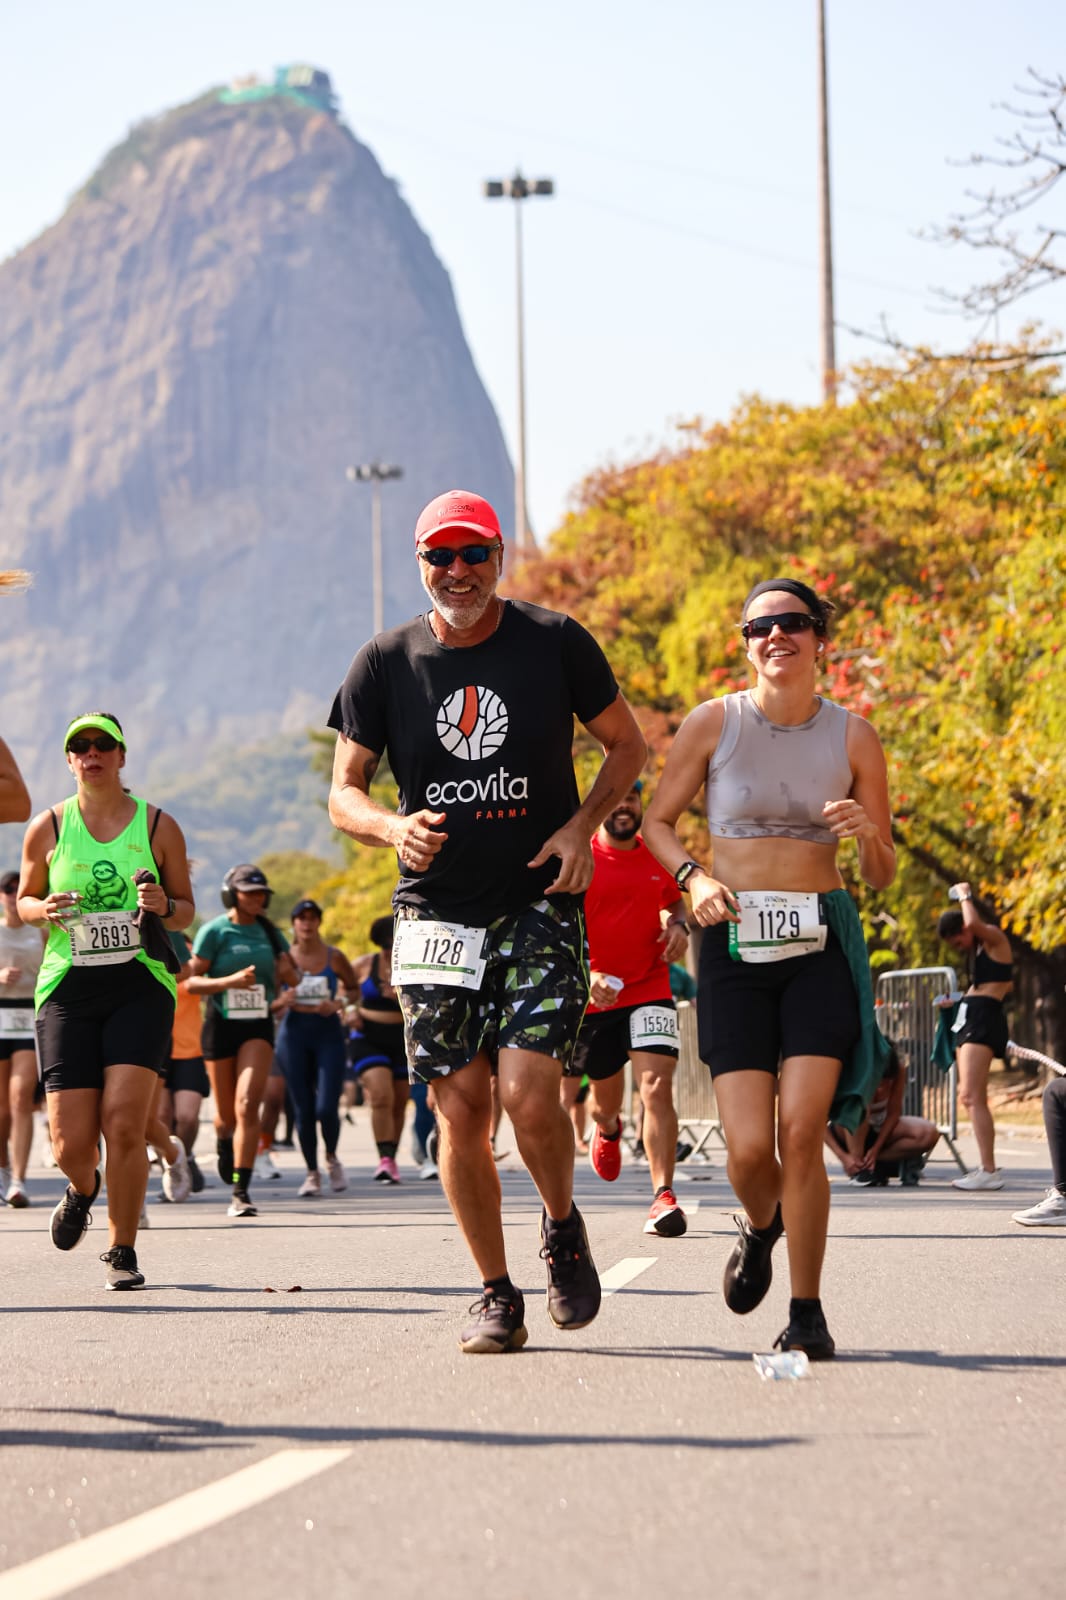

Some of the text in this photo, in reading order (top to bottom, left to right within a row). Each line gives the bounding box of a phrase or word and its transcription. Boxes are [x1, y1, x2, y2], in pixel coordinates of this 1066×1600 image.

[426, 766, 528, 806] ecovita
[476, 808, 527, 819] FARMA
[90, 925, 130, 949] 2693
[758, 910, 800, 940] 1129
[394, 936, 402, 971] BRANCO
[422, 938, 464, 966] 1128
